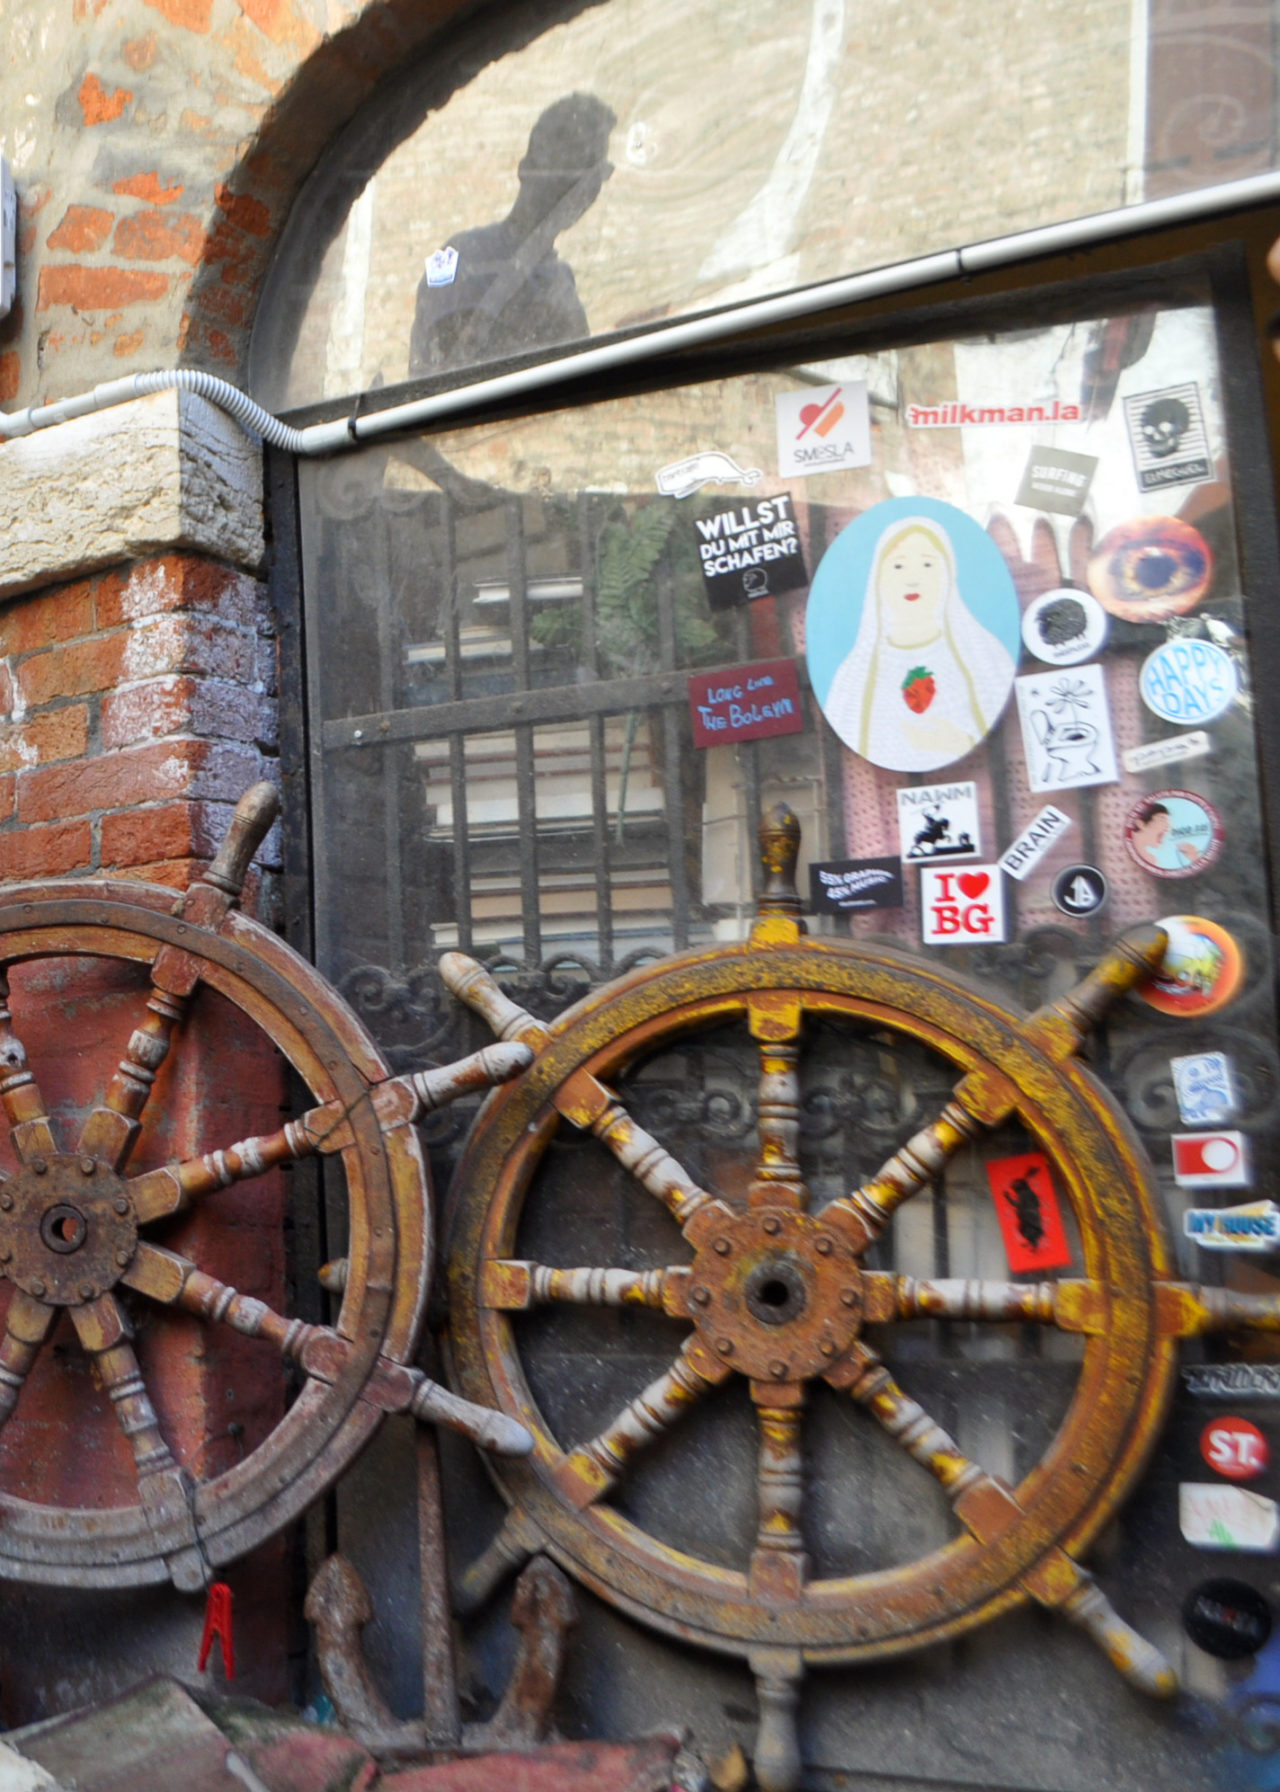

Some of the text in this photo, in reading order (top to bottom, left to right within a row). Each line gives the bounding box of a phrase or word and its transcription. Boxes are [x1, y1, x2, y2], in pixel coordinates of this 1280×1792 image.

[909, 400, 1080, 425] milkman.la
[695, 495, 790, 541] WILLST
[699, 519, 797, 561] DU MIT MIR
[702, 536, 799, 578] SCHAFEN?
[707, 685, 744, 705] LONG
[900, 784, 973, 806] NAWM
[1004, 810, 1062, 872] BRAIN
[934, 872, 957, 902] I
[930, 902, 995, 936] BG
[1208, 1428, 1261, 1467] ST.
